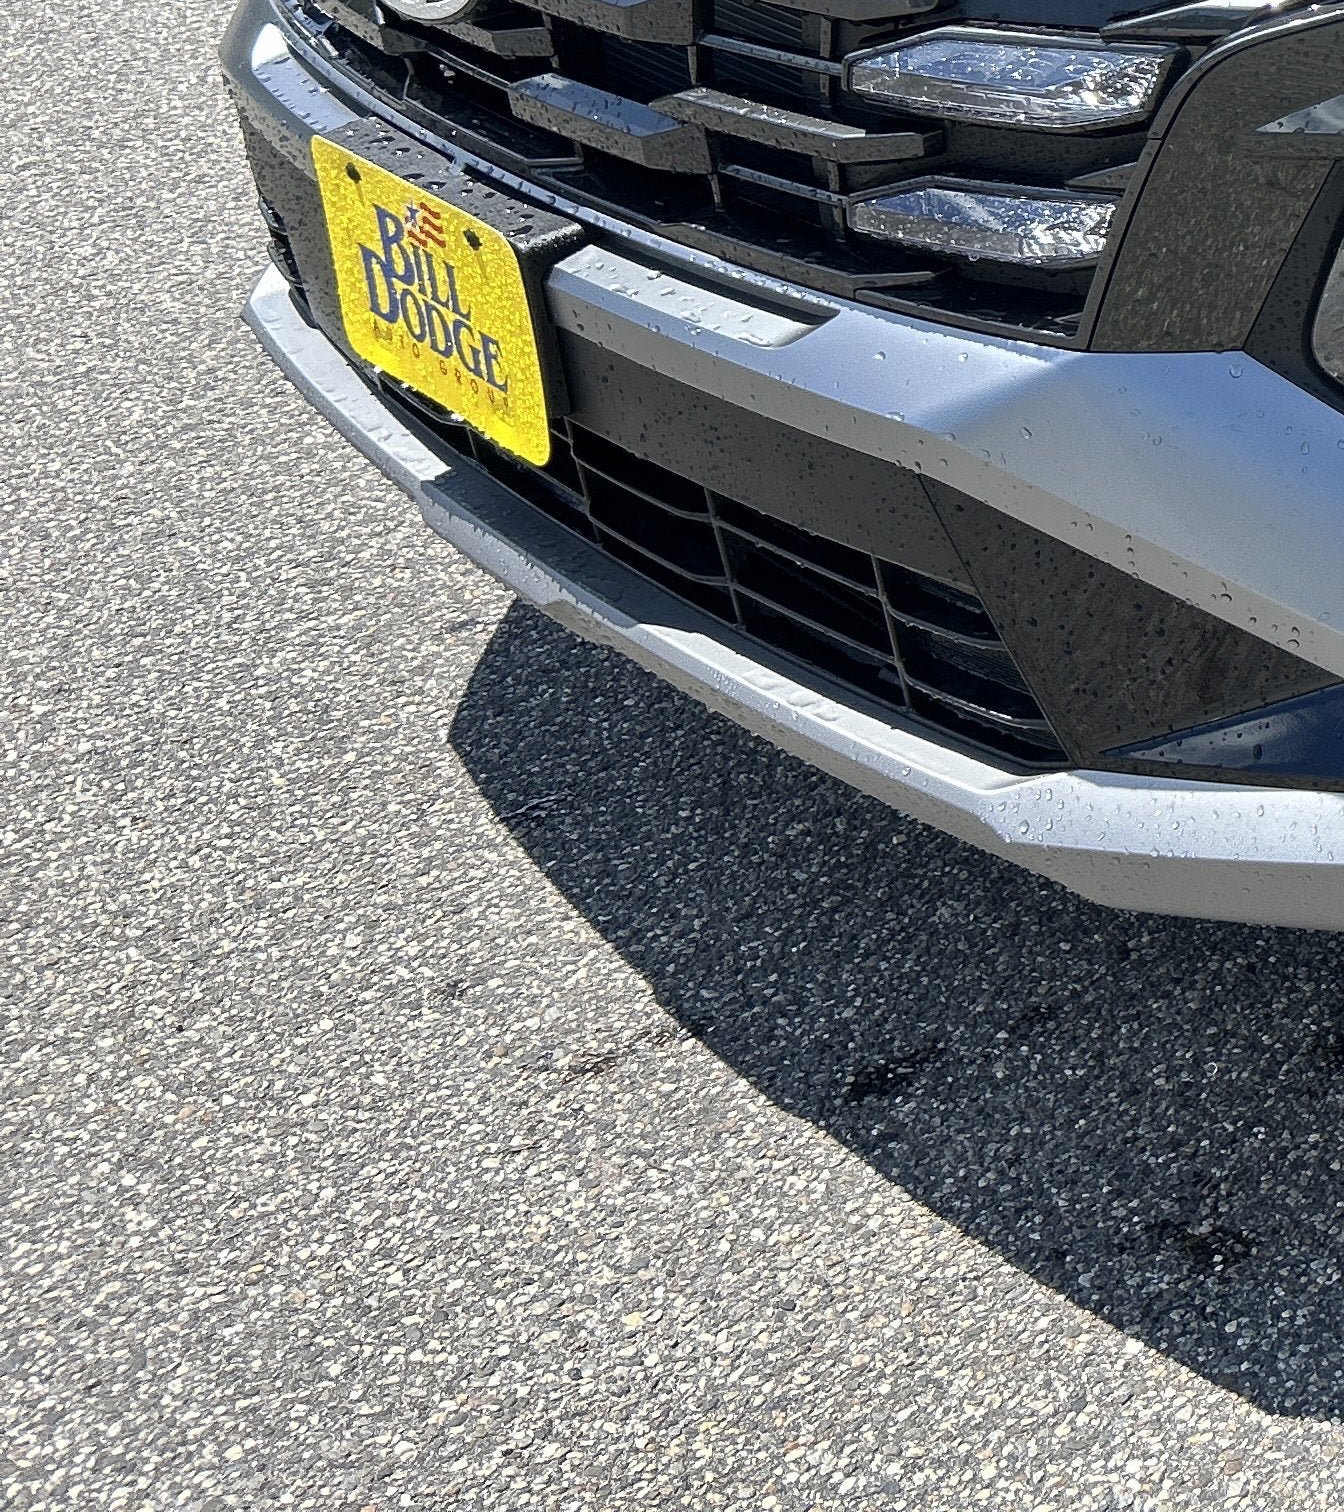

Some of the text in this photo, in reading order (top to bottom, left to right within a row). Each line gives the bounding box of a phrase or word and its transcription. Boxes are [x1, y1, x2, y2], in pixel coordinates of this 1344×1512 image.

[358, 243, 510, 395] DODGE
[372, 203, 473, 322] BILL
[439, 359, 509, 410] GROUP
